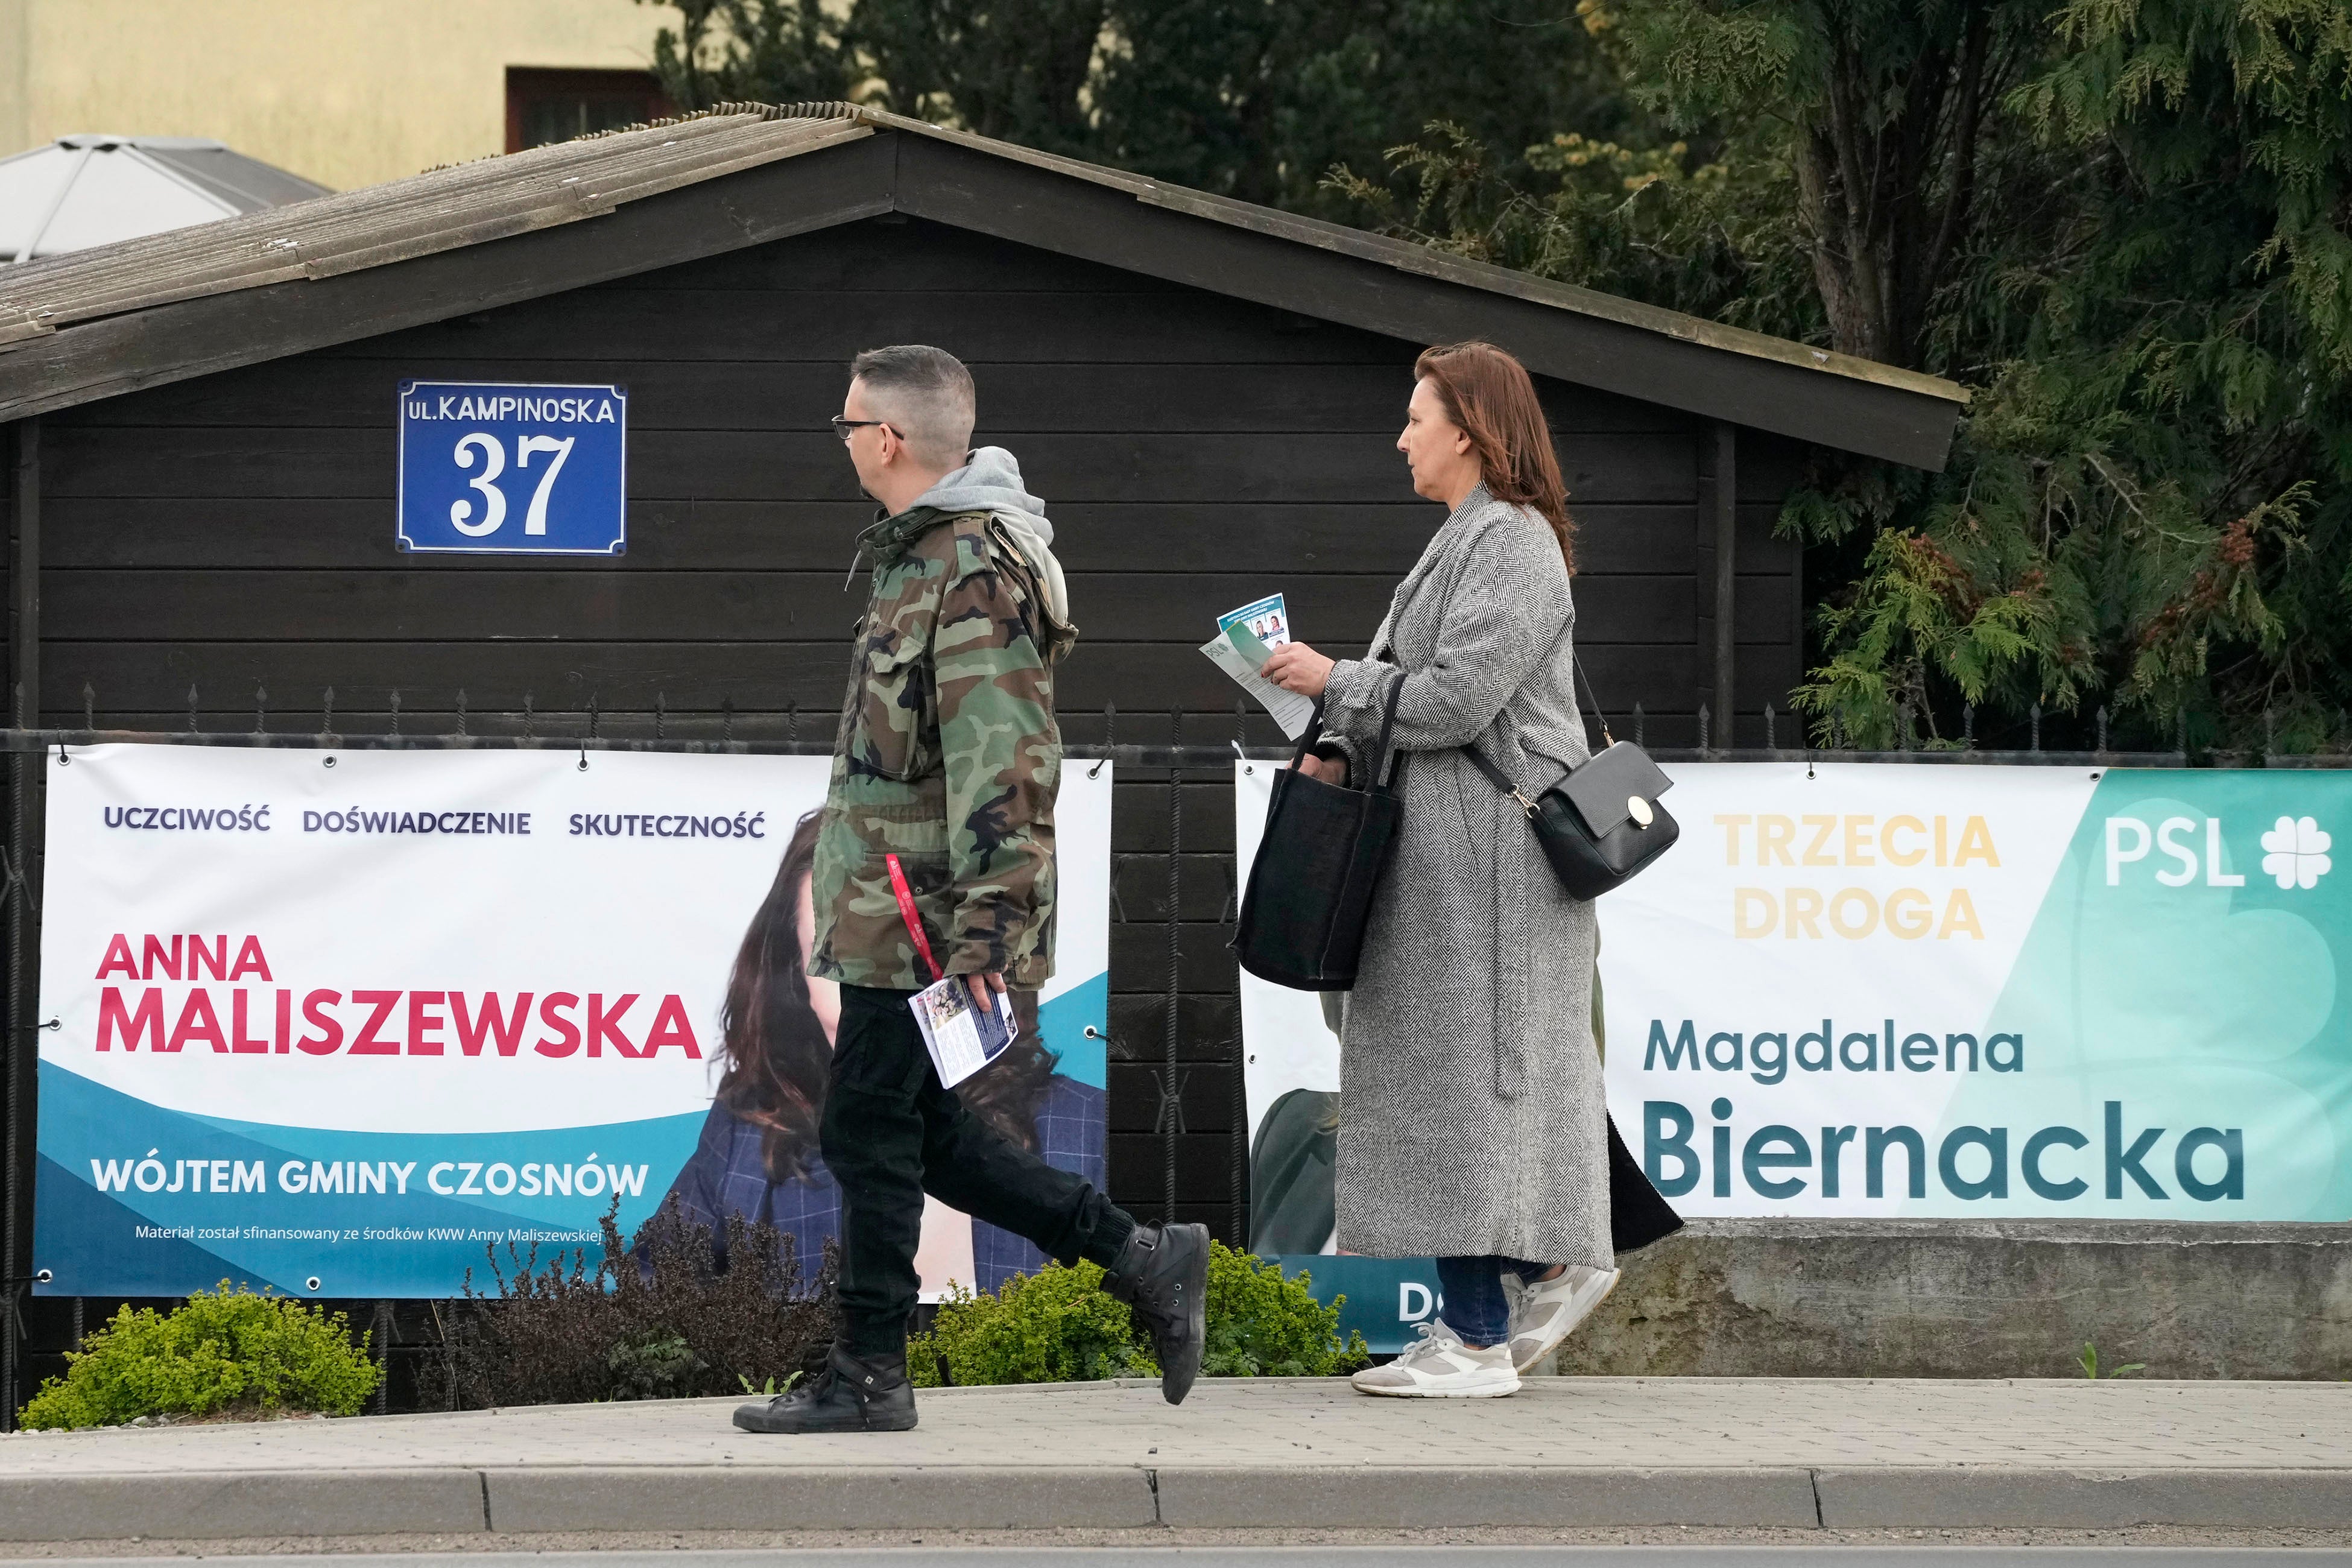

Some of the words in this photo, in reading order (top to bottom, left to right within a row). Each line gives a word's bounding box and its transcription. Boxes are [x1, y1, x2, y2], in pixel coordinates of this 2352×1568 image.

[450, 432, 575, 537] 37
[1206, 646, 1224, 659] PSL
[104, 804, 271, 831] UCZCIWOŚĆ
[303, 806, 531, 835] DOŚWIADCZENIE
[569, 811, 766, 839] SKUTECZNOŚĆ
[1713, 814, 2002, 868] TRZECIA
[2105, 817, 2245, 888] PSL
[1734, 887, 1985, 940] DROGA
[95, 933, 274, 982] ANNA
[95, 987, 703, 1059] MALISZEWSKA
[1643, 1019, 2024, 1086] Magdalena
[90, 1148, 266, 1193] WÓJTEM
[277, 1160, 417, 1194] GMINY
[427, 1152, 650, 1197] CZOSNÓW
[1643, 1097, 2245, 1202] Biernacka
[135, 1225, 195, 1239] Materiał
[198, 1226, 240, 1239] został
[243, 1226, 340, 1244] sfinansowany
[343, 1229, 359, 1240] ze
[363, 1227, 423, 1241] środków
[428, 1228, 465, 1241] KWW
[467, 1228, 504, 1245] Anny
[508, 1228, 602, 1245] Maliszewskiej
